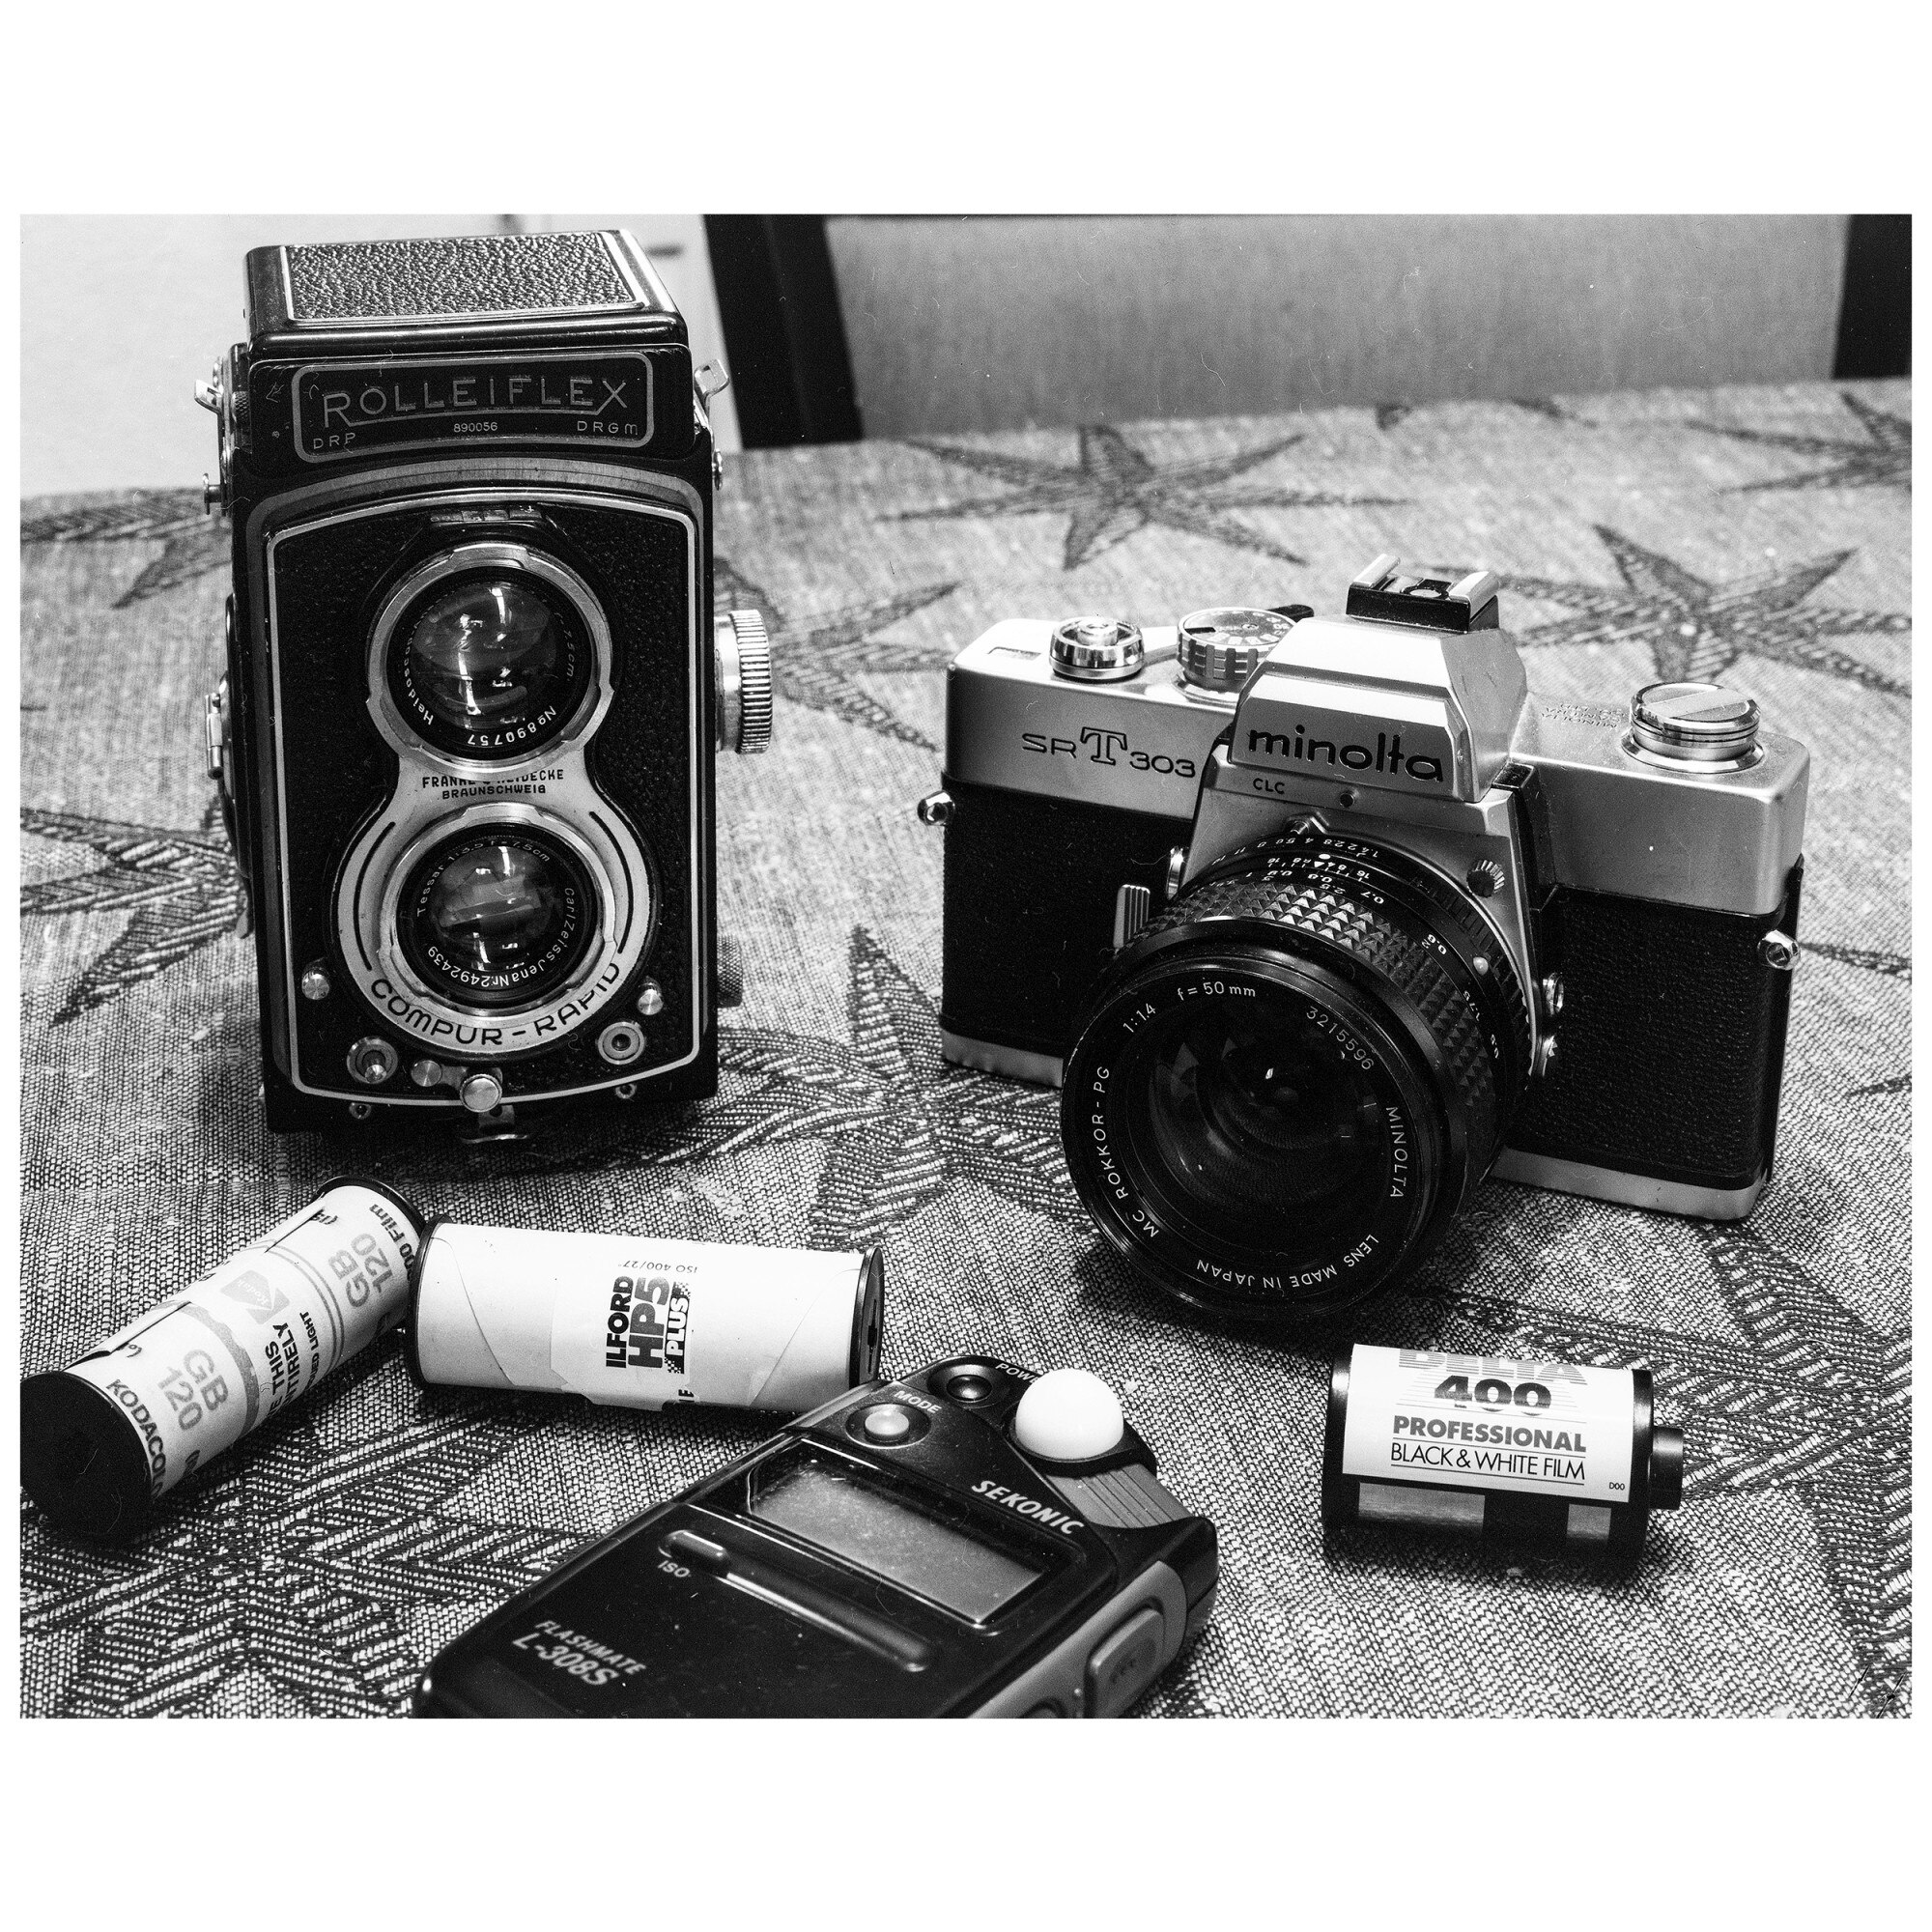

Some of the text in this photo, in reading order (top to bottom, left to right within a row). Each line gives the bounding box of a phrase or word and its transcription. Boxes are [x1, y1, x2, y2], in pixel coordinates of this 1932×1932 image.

[323, 377, 628, 428] ROLLEIFLEX
[453, 421, 498, 433] 890056
[313, 432, 356, 449] DRP
[1248, 724, 1444, 782] minolta
[441, 784, 547, 800] BRAUNSCHWEIG
[1253, 777, 1286, 795] CLC
[1360, 891, 1384, 904] 0.7
[1306, 1006, 1375, 1070] 3215596
[1386, 1106, 1408, 1199] MINOLTA
[369, 1204, 406, 1243] Film
[1132, 1208, 1159, 1238] MC
[328, 1249, 371, 1308] GB
[351, 1233, 393, 1293] 120
[675, 1264, 697, 1273] ISO
[1197, 1234, 1379, 1290] LENS MADE IN JAPAN
[299, 1311, 319, 1350] LIGHT
[606, 1275, 634, 1369] ILFORD
[628, 1276, 670, 1369] HP5
[666, 1297, 690, 1356] PLUS
[184, 1349, 229, 1411] GB
[265, 1341, 285, 1396] THIS
[1399, 1351, 1588, 1385] DELTA
[157, 1366, 203, 1432] 120
[894, 1390, 942, 1414] MODE
[1434, 1375, 1552, 1416] 400
[1393, 1414, 1587, 1453] PROFESSIONAL
[1391, 1442, 1586, 1481] BLACK & WHITE FILM
[971, 1480, 1085, 1535] SEKONIC
[657, 1560, 690, 1577] ISO
[511, 1633, 619, 1687] L-308S
[534, 1620, 647, 1676] FLASHMATE
